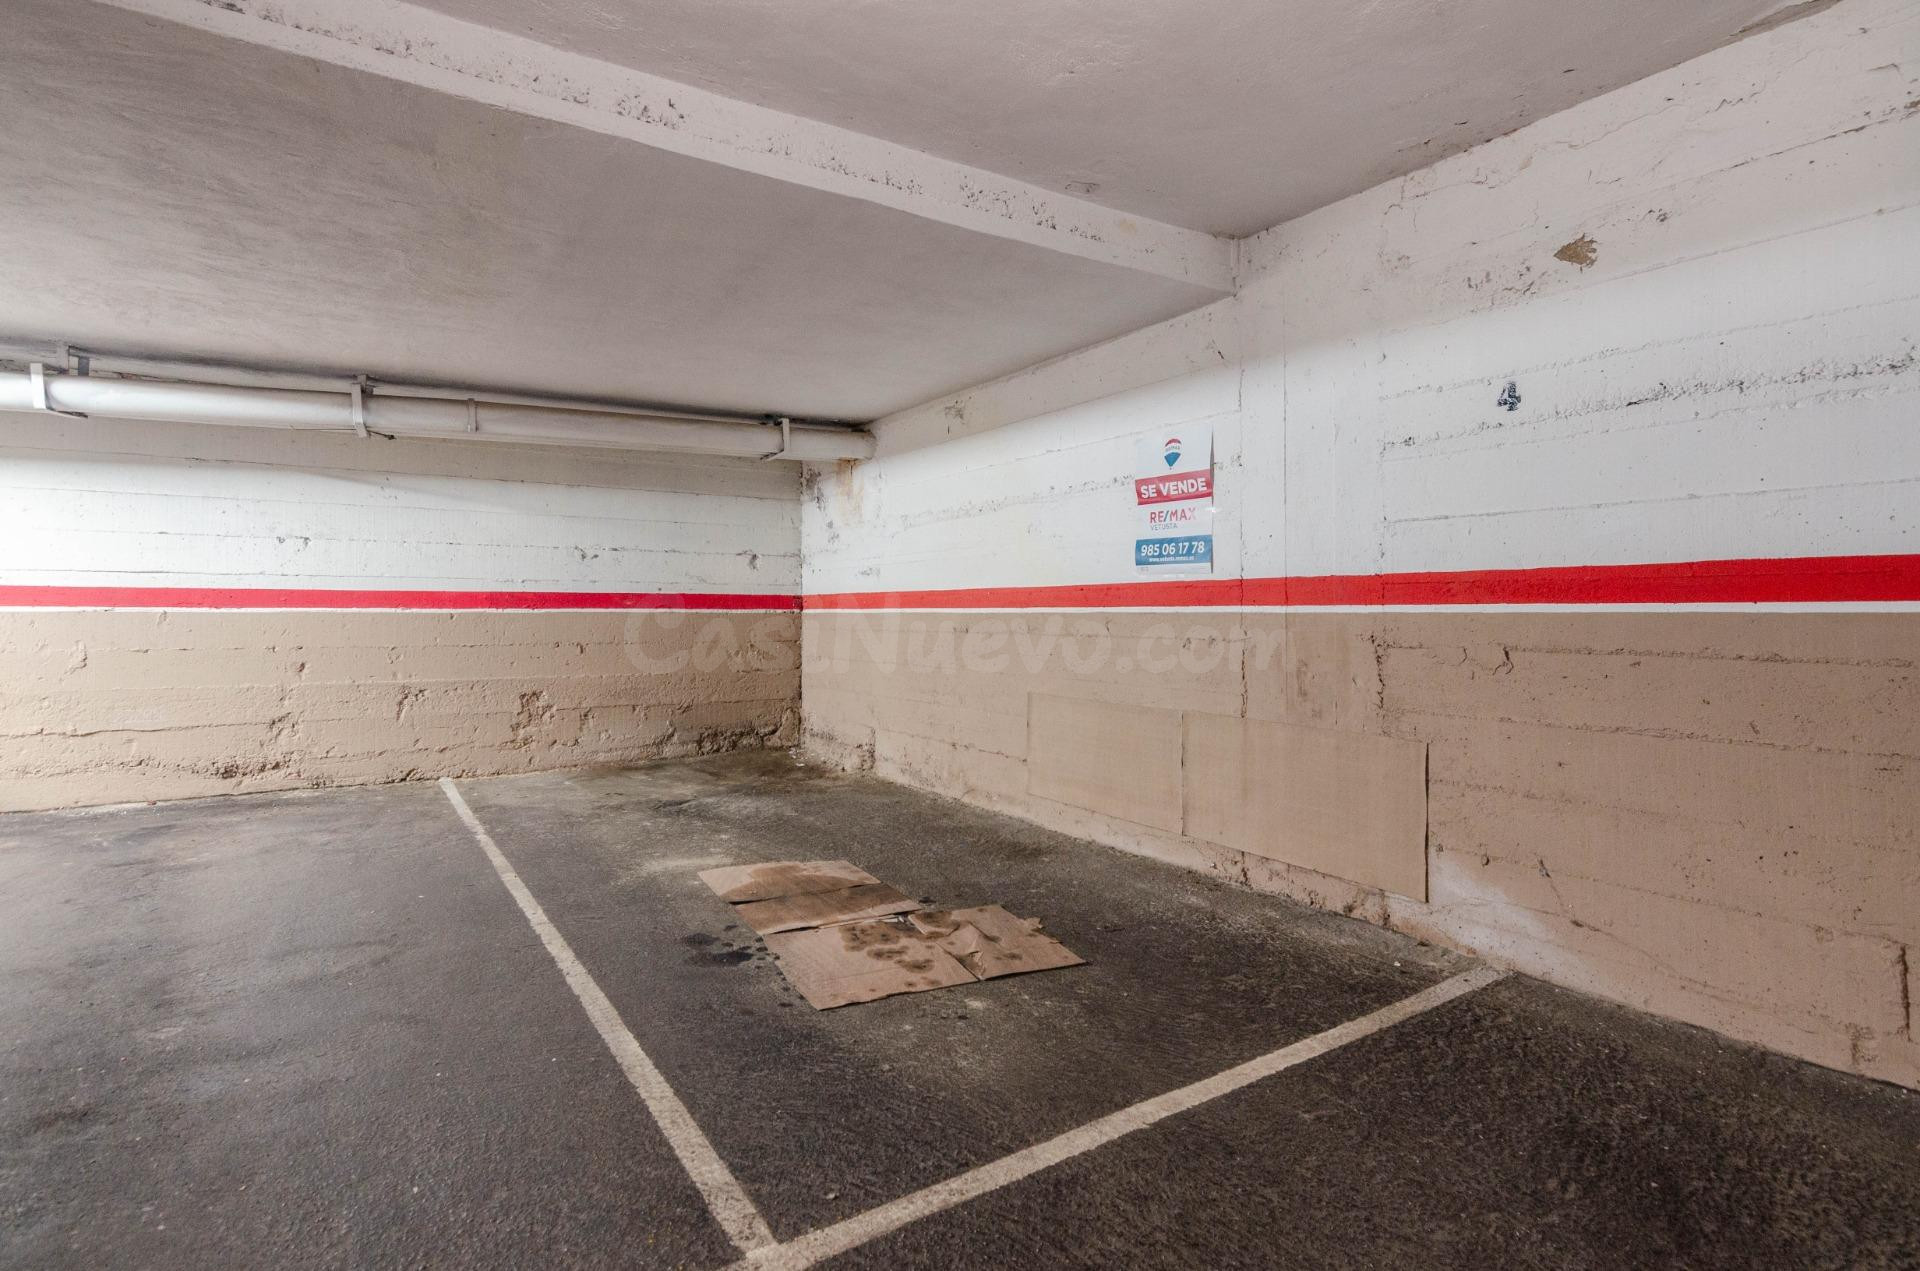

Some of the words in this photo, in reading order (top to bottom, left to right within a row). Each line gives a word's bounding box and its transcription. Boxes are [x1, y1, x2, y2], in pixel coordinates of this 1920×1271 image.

[1497, 381, 1521, 412] 4
[1141, 485, 1157, 498] SE
[1160, 478, 1207, 496] VENDE
[1150, 508, 1196, 523] RE/MAX
[1141, 544, 1160, 556] 985
[1162, 543, 1176, 555] 06
[1178, 542, 1188, 554] 17
[1192, 541, 1205, 553] 78
